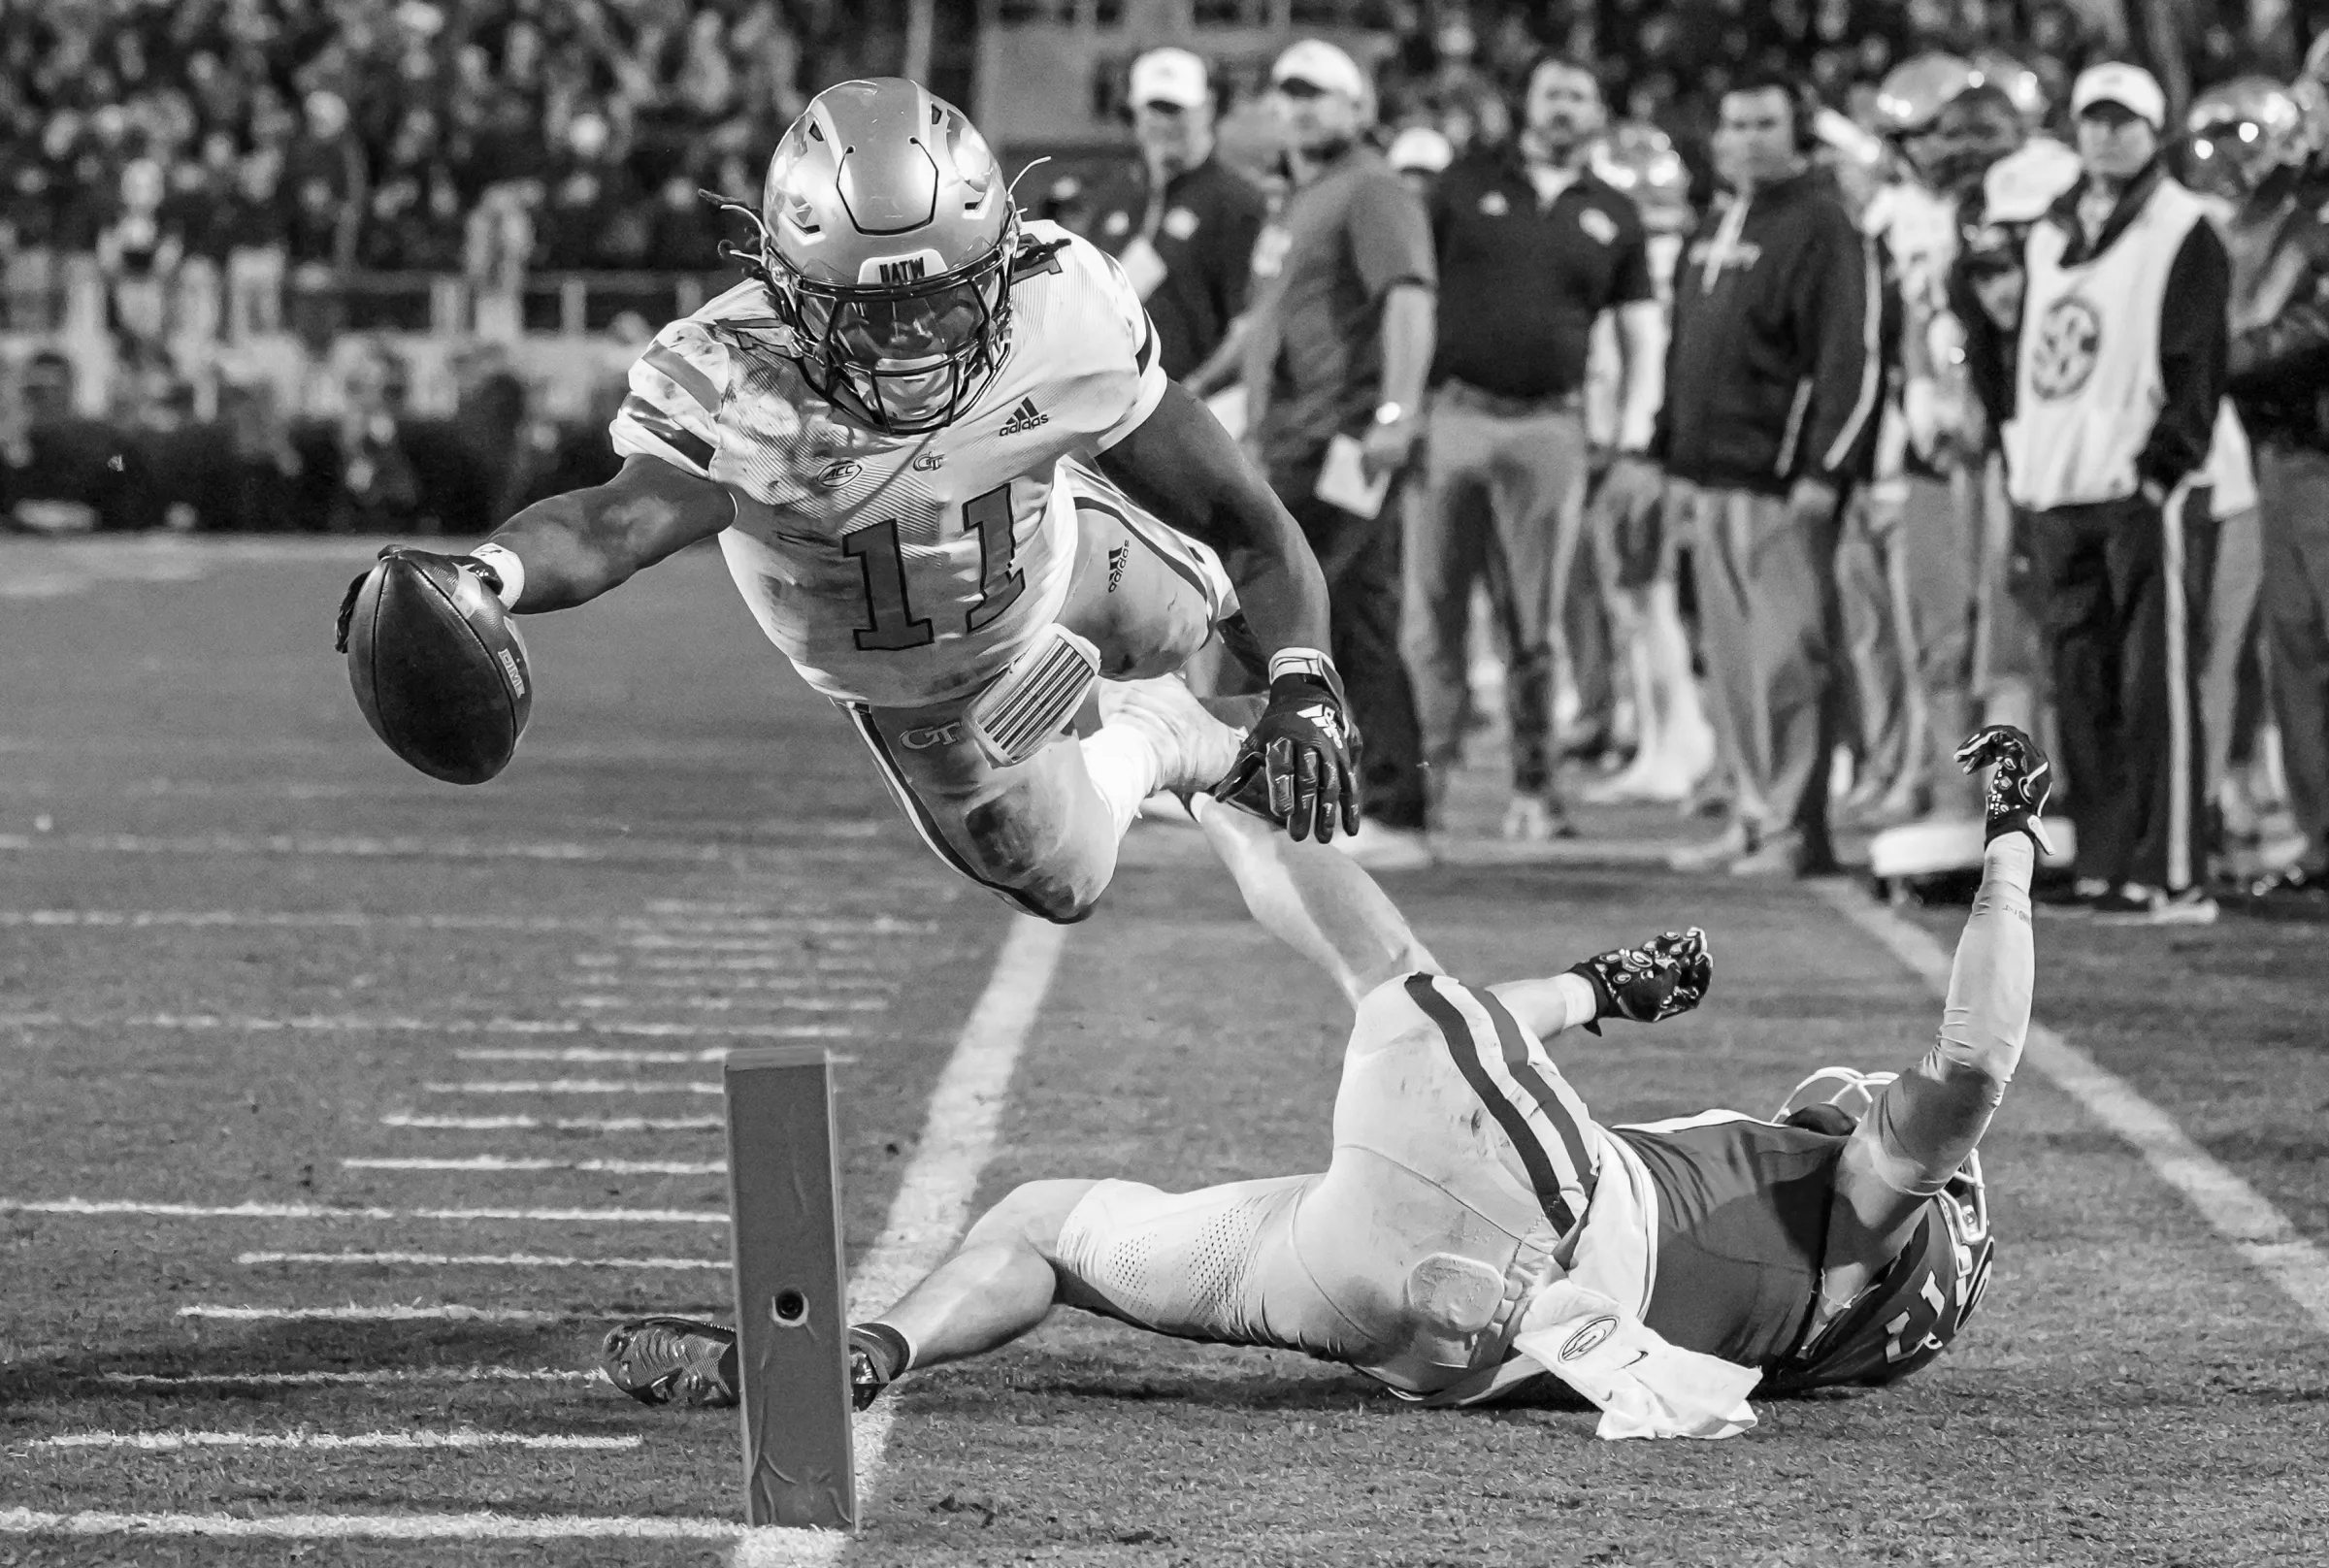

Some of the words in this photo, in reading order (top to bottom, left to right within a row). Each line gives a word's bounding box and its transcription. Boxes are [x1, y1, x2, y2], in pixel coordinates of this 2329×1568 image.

[999, 414, 1049, 437] adidas
[822, 465, 855, 480] ACC
[842, 481, 1026, 651] 11
[1108, 539, 1130, 593] adidas
[899, 721, 961, 750] GT
